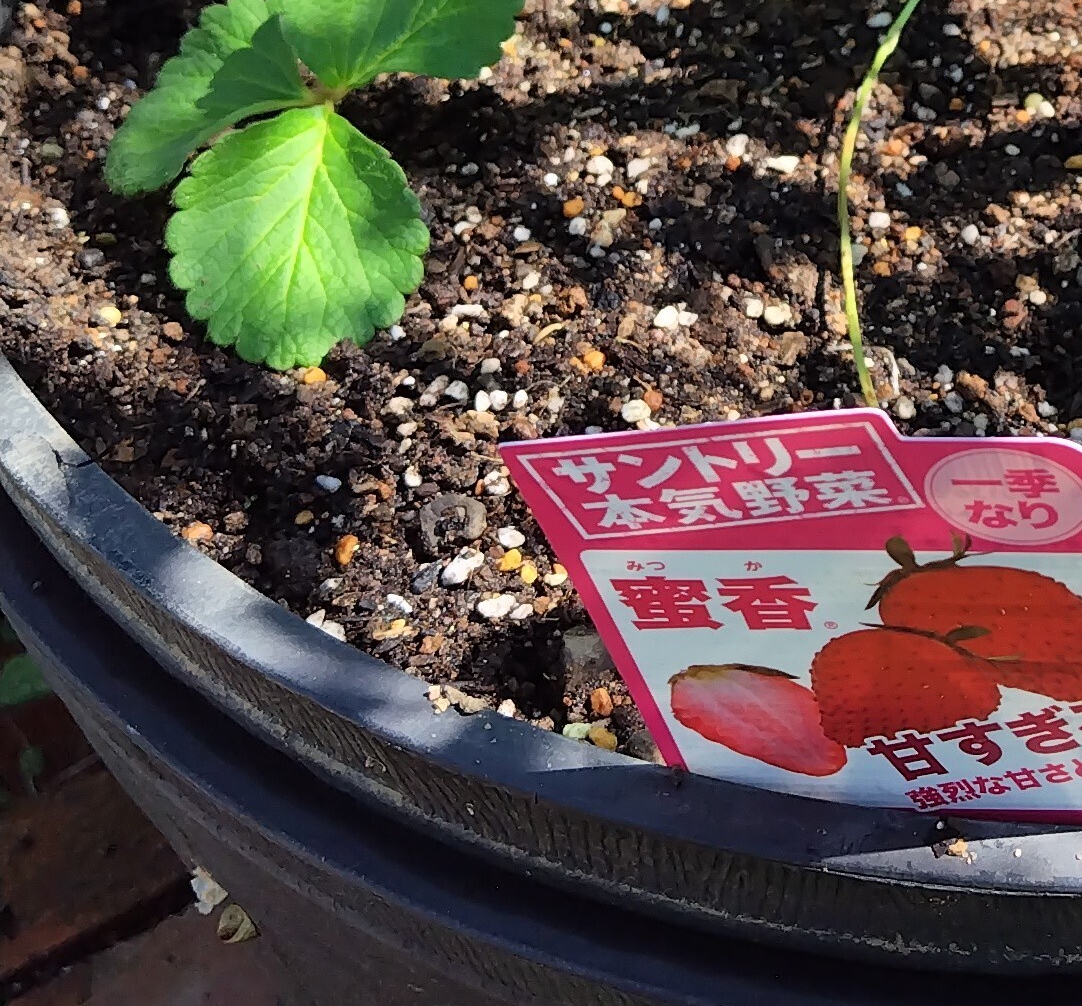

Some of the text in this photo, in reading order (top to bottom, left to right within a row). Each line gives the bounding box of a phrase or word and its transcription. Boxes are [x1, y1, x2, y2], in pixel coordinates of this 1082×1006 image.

[552, 437, 861, 493] サントリー
[951, 468, 1060, 498] 一季
[581, 470, 893, 530] 本気野菜
[965, 500, 1059, 529] なり
[626, 560, 763, 572] みつ か
[609, 575, 819, 631] 蜜香
